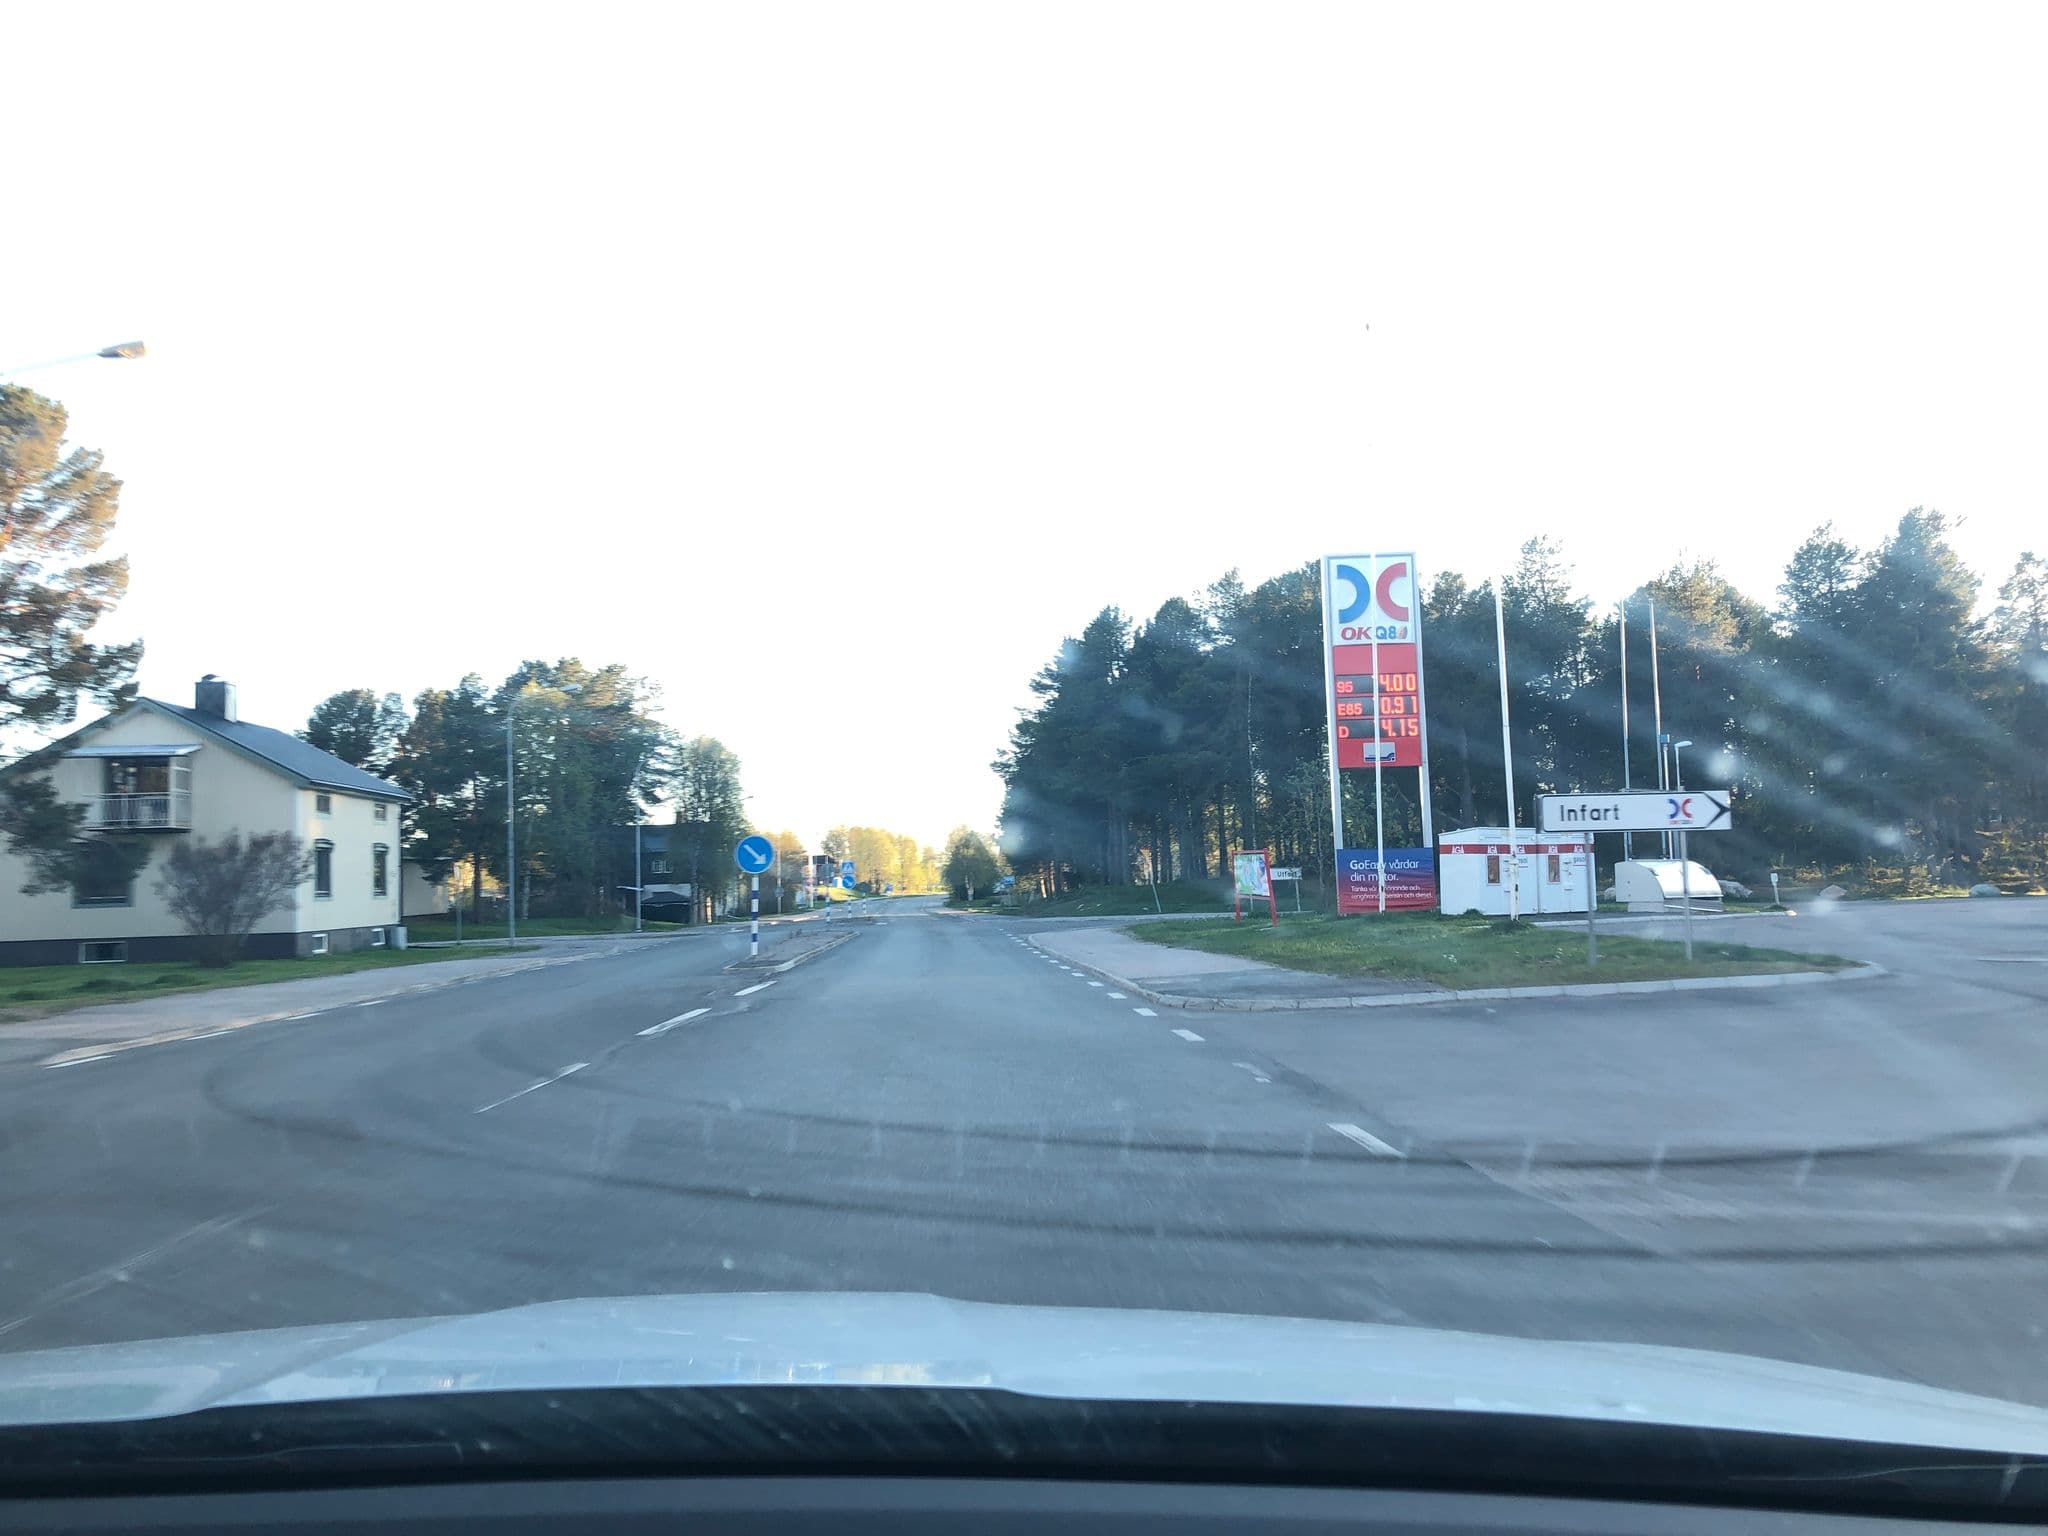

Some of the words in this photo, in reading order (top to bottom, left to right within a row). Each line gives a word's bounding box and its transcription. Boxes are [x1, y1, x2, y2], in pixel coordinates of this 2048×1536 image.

[1336, 681, 1353, 693] 95
[1379, 673, 1416, 691] 4.00
[1337, 703, 1363, 716] E85
[1381, 695, 1418, 714] 0.91
[1338, 726, 1349, 738] D
[1382, 718, 1419, 737] 4.15
[1560, 803, 1620, 822] Infart
[1389, 859, 1419, 869] vårdar
[1350, 871, 1365, 882] din
[1368, 873, 1399, 882] mtor.
